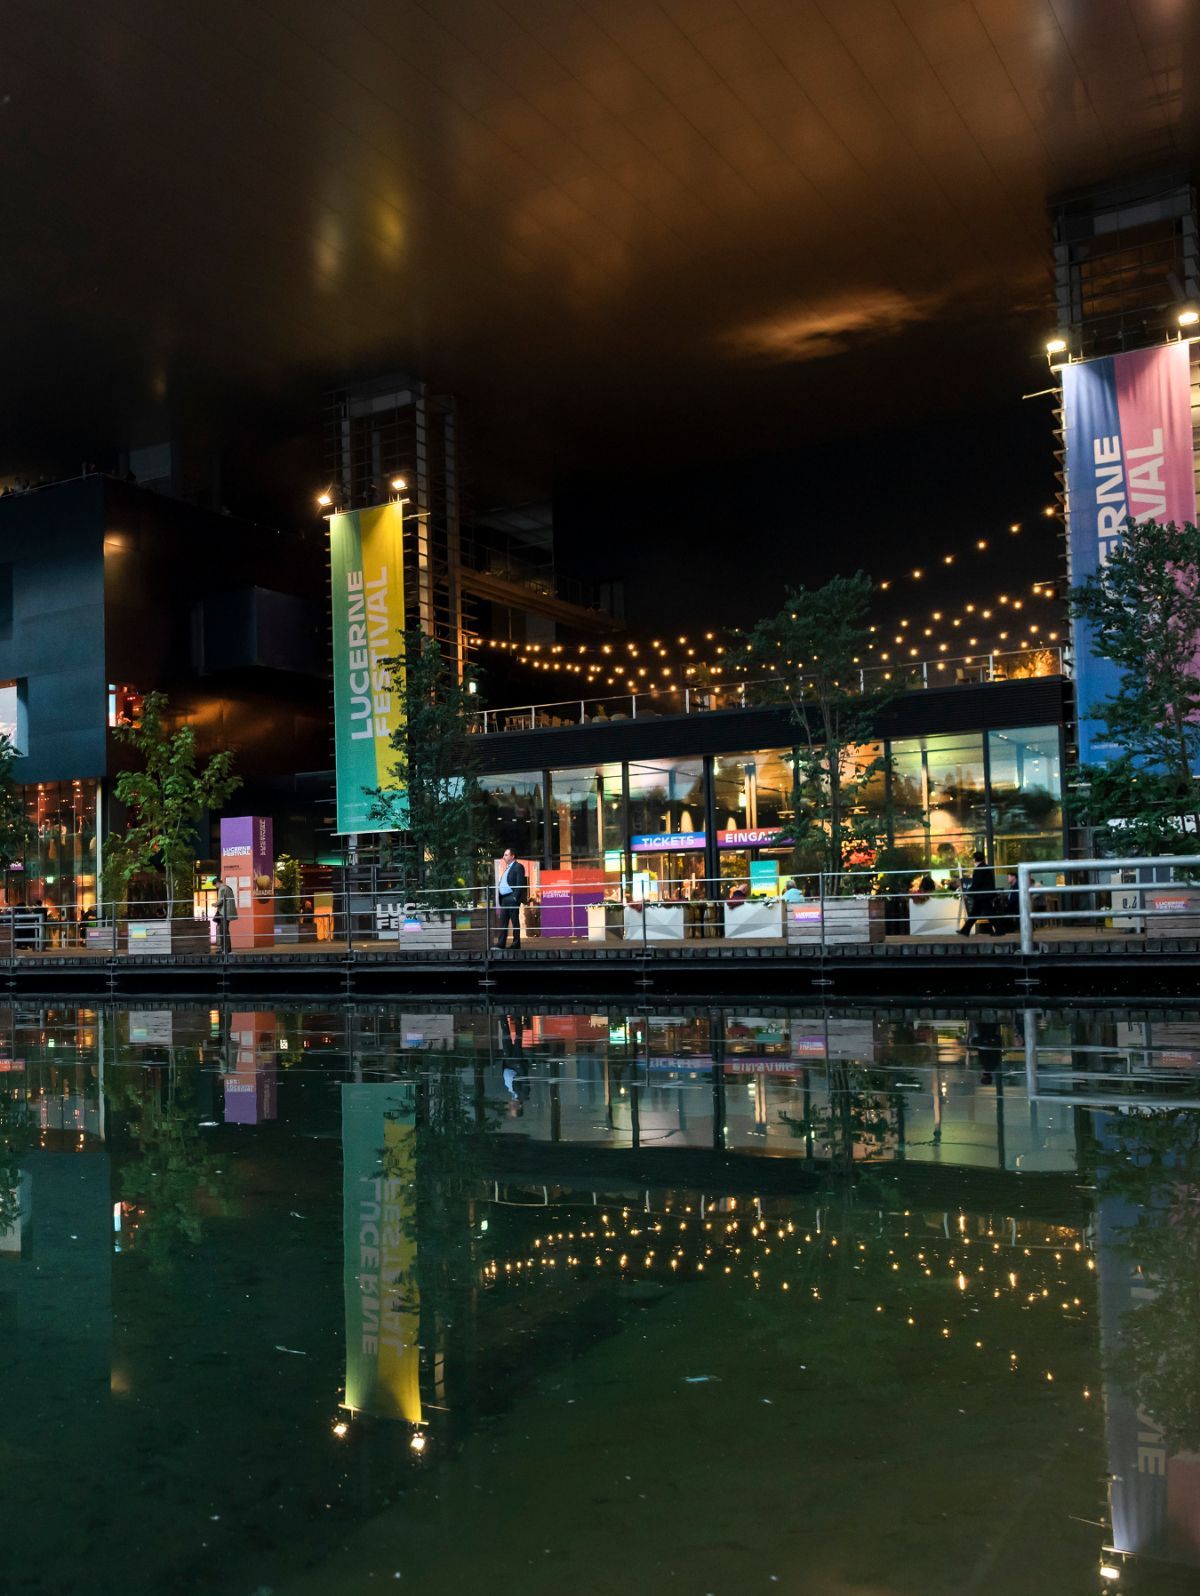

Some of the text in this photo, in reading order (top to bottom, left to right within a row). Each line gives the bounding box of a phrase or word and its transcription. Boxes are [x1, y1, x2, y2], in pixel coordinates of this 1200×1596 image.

[347, 570, 373, 740] LUCERNE
[366, 566, 391, 737] FESTIVAL
[641, 835, 695, 848] TICKETS
